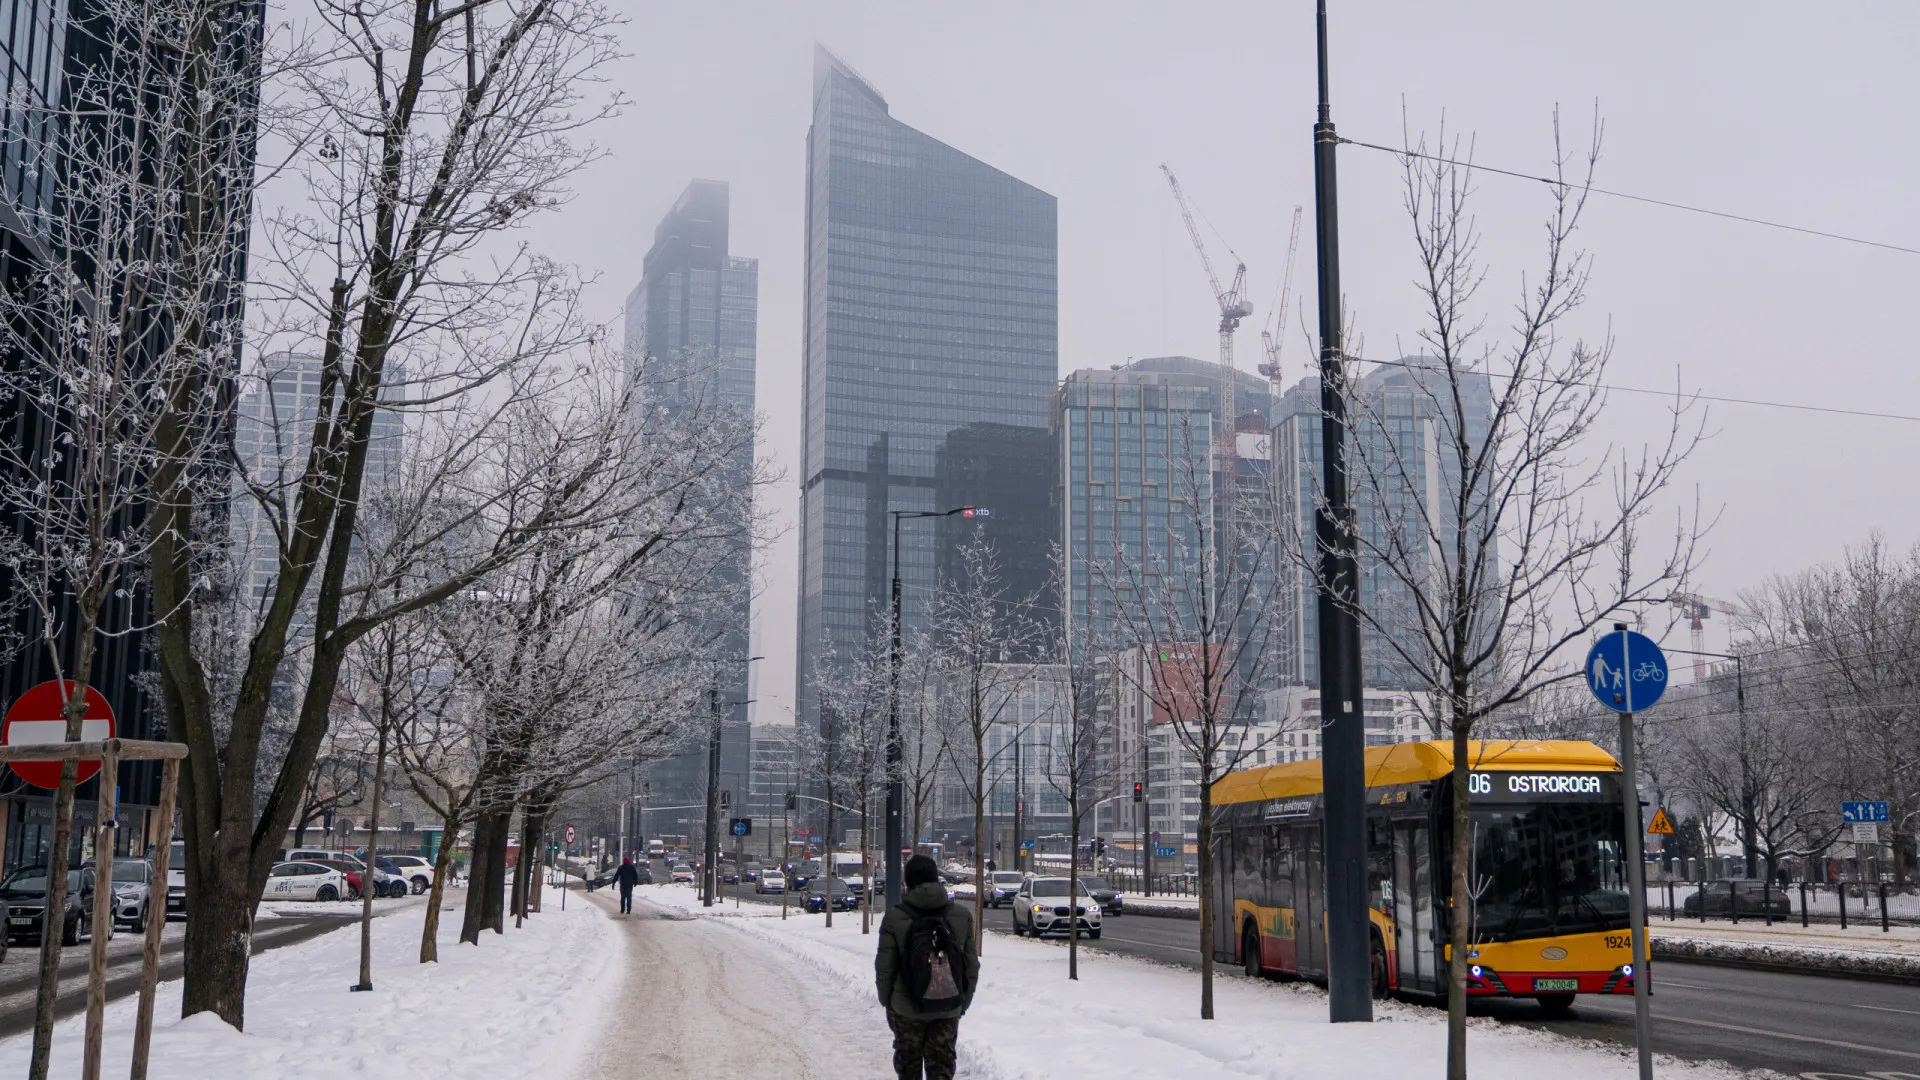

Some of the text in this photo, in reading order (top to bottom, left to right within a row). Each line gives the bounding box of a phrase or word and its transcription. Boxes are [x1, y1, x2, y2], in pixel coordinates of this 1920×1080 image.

[976, 508, 990, 516] xtb
[1469, 774, 1601, 793] 06 OSTROROGA
[1604, 936, 1631, 948] 1924
[1538, 980, 1575, 988] WX 2004F
